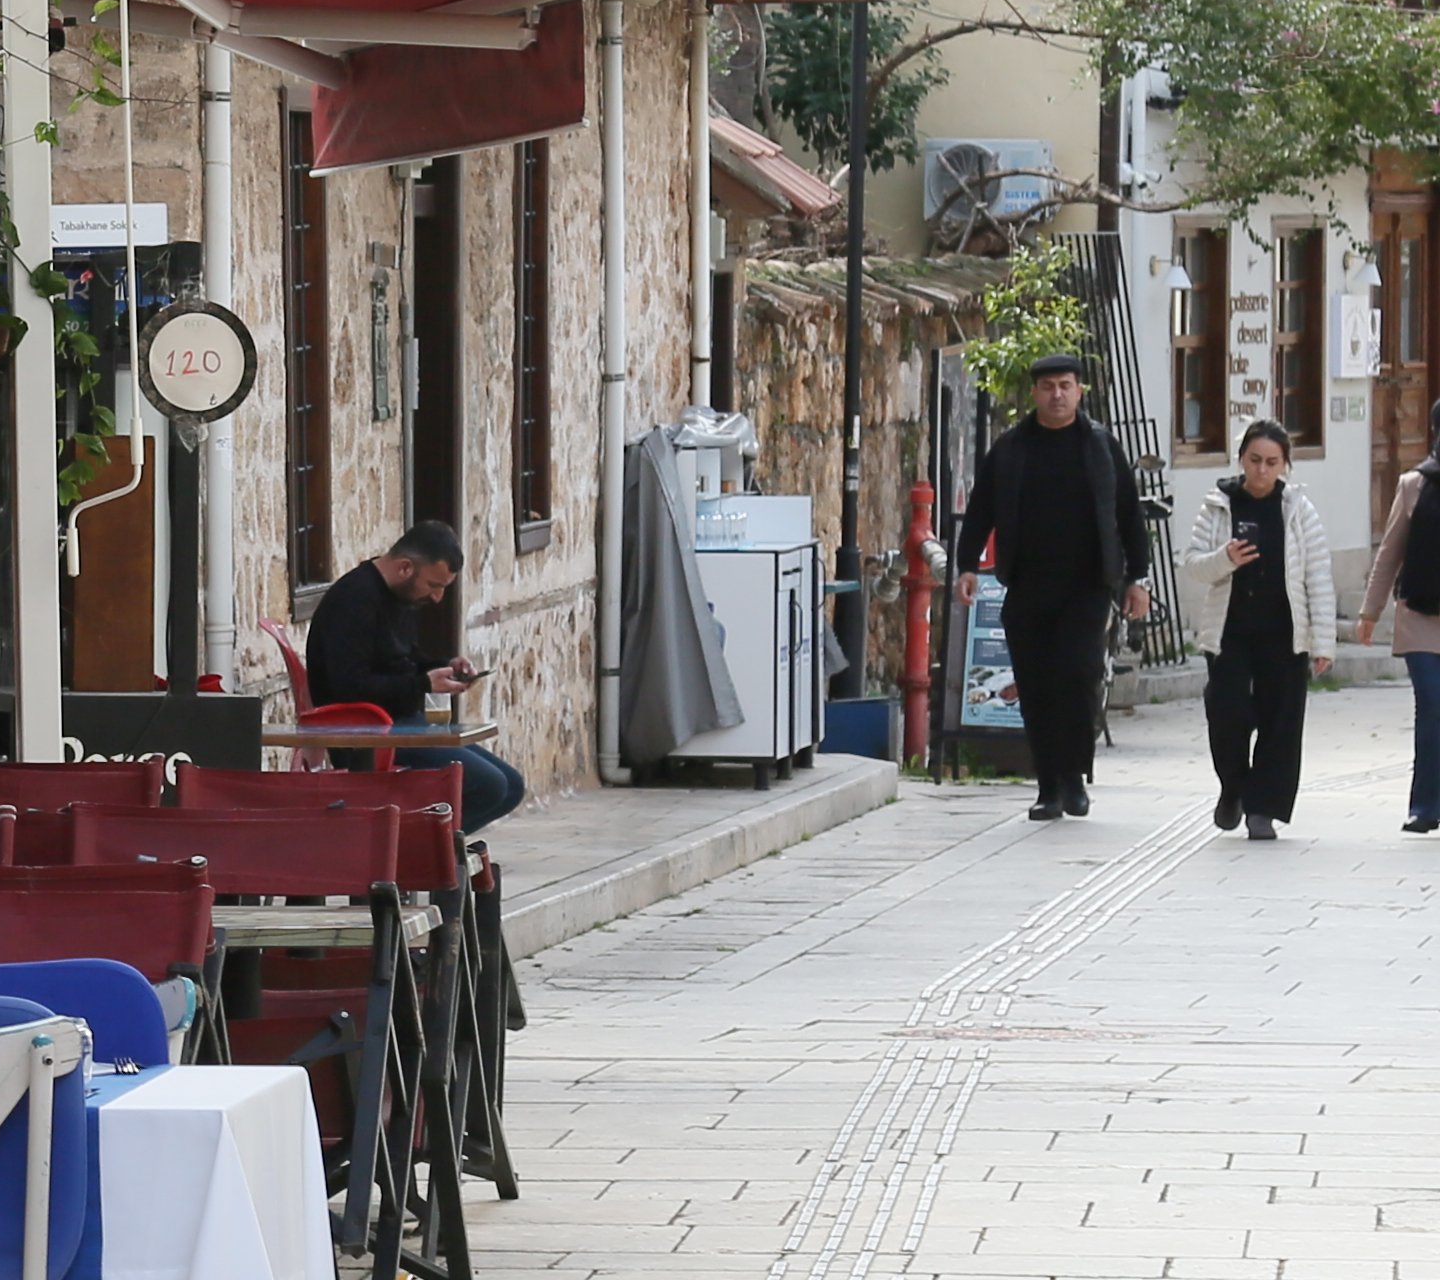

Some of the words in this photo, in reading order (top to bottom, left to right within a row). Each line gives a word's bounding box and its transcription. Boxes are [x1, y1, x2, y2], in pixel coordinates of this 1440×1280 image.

[60, 220, 109, 231] Tabakhane
[110, 220, 138, 231] Sokk
[165, 349, 222, 377] 120
